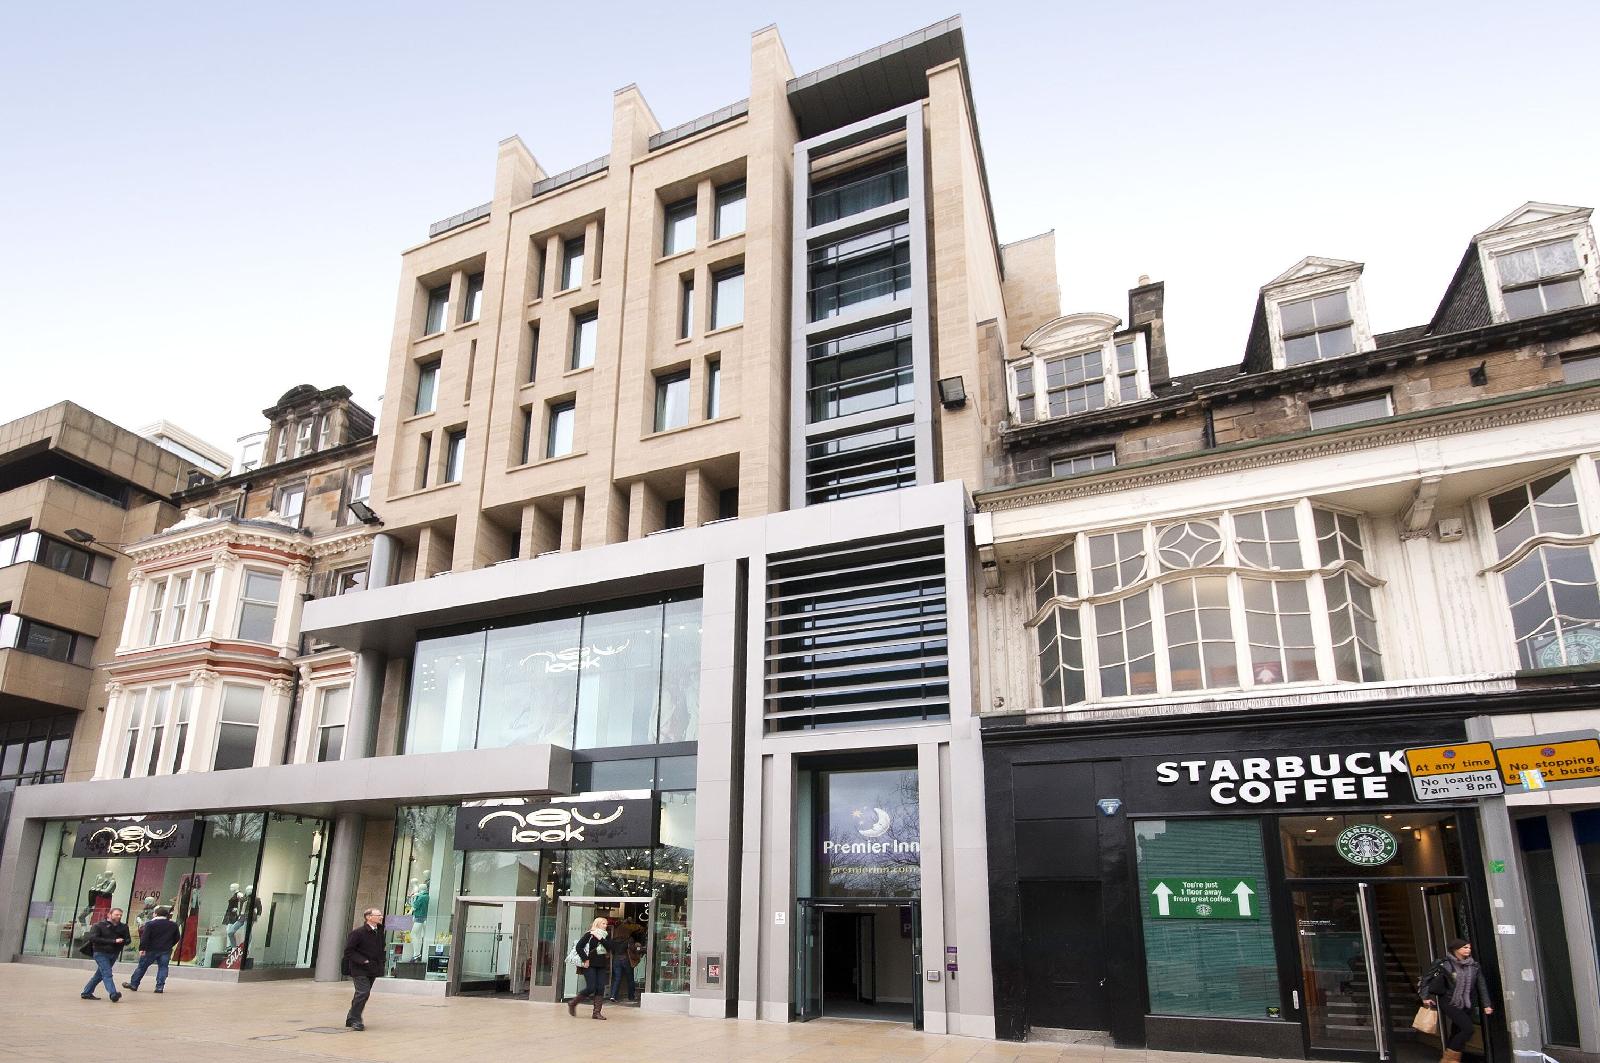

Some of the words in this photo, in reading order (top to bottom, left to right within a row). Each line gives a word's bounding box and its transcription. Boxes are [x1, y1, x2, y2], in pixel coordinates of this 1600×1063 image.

[545, 656, 600, 673] look
[1156, 750, 1407, 783] STARBUCK
[1415, 764, 1429, 772] At
[1509, 762, 1528, 771] No
[1535, 756, 1594, 768] stopping
[1560, 765, 1600, 775] buses
[1421, 779, 1439, 787] No
[1445, 774, 1492, 784] loading
[1210, 776, 1389, 804] COFFEE
[478, 805, 624, 829] new
[90, 824, 178, 841] new
[511, 824, 585, 843] look
[1340, 827, 1391, 844] STARBUCKS
[107, 839, 152, 854] look
[823, 840, 890, 854] Premier
[893, 840, 920, 853] Inn
[1347, 852, 1389, 863] COFFEE
[1204, 881, 1218, 889] just
[1204, 889, 1221, 897] away
[225, 946, 244, 969] SALE
